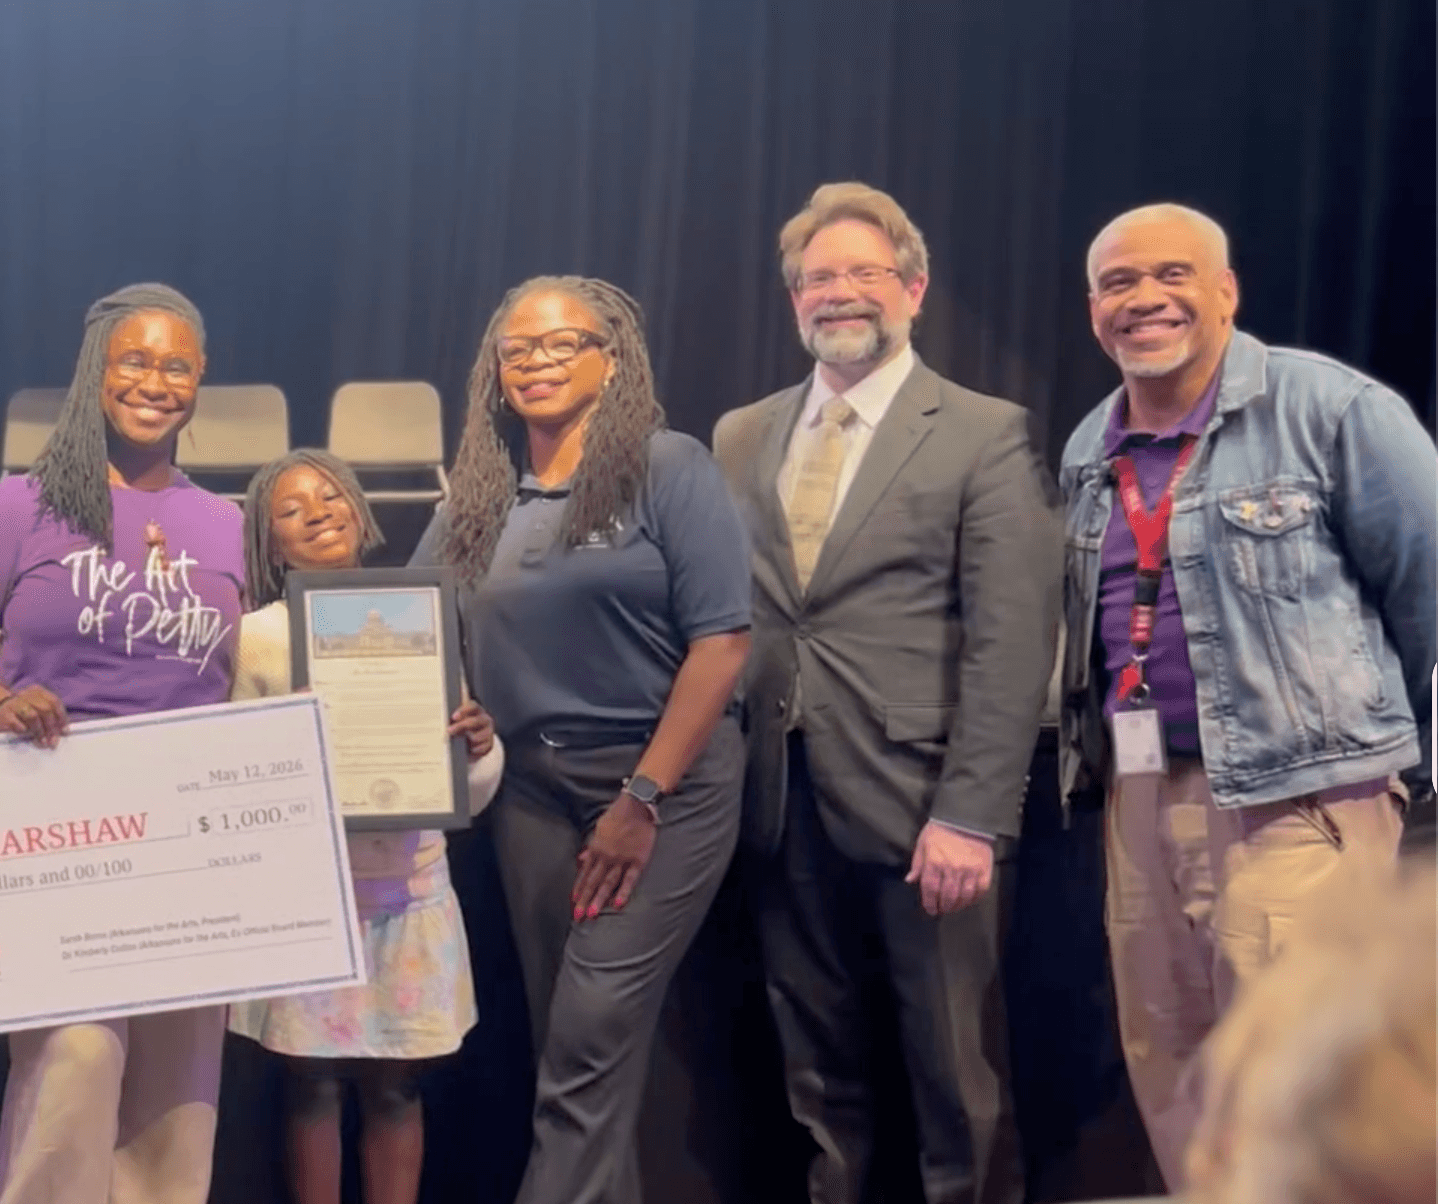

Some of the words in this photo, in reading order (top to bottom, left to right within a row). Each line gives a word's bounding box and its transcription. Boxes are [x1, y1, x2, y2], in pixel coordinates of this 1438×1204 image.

[61, 546, 136, 600] The
[146, 546, 199, 607] Art
[78, 591, 114, 643] of
[121, 592, 232, 675] Petty
[176, 782, 202, 793] DATE
[209, 769, 239, 783] May
[244, 764, 265, 779] 12,
[269, 758, 304, 775] 2026
[198, 815, 211, 833] $
[40, 866, 70, 885] and
[74, 858, 133, 881] 00/100
[208, 853, 262, 867] DOLLARS
